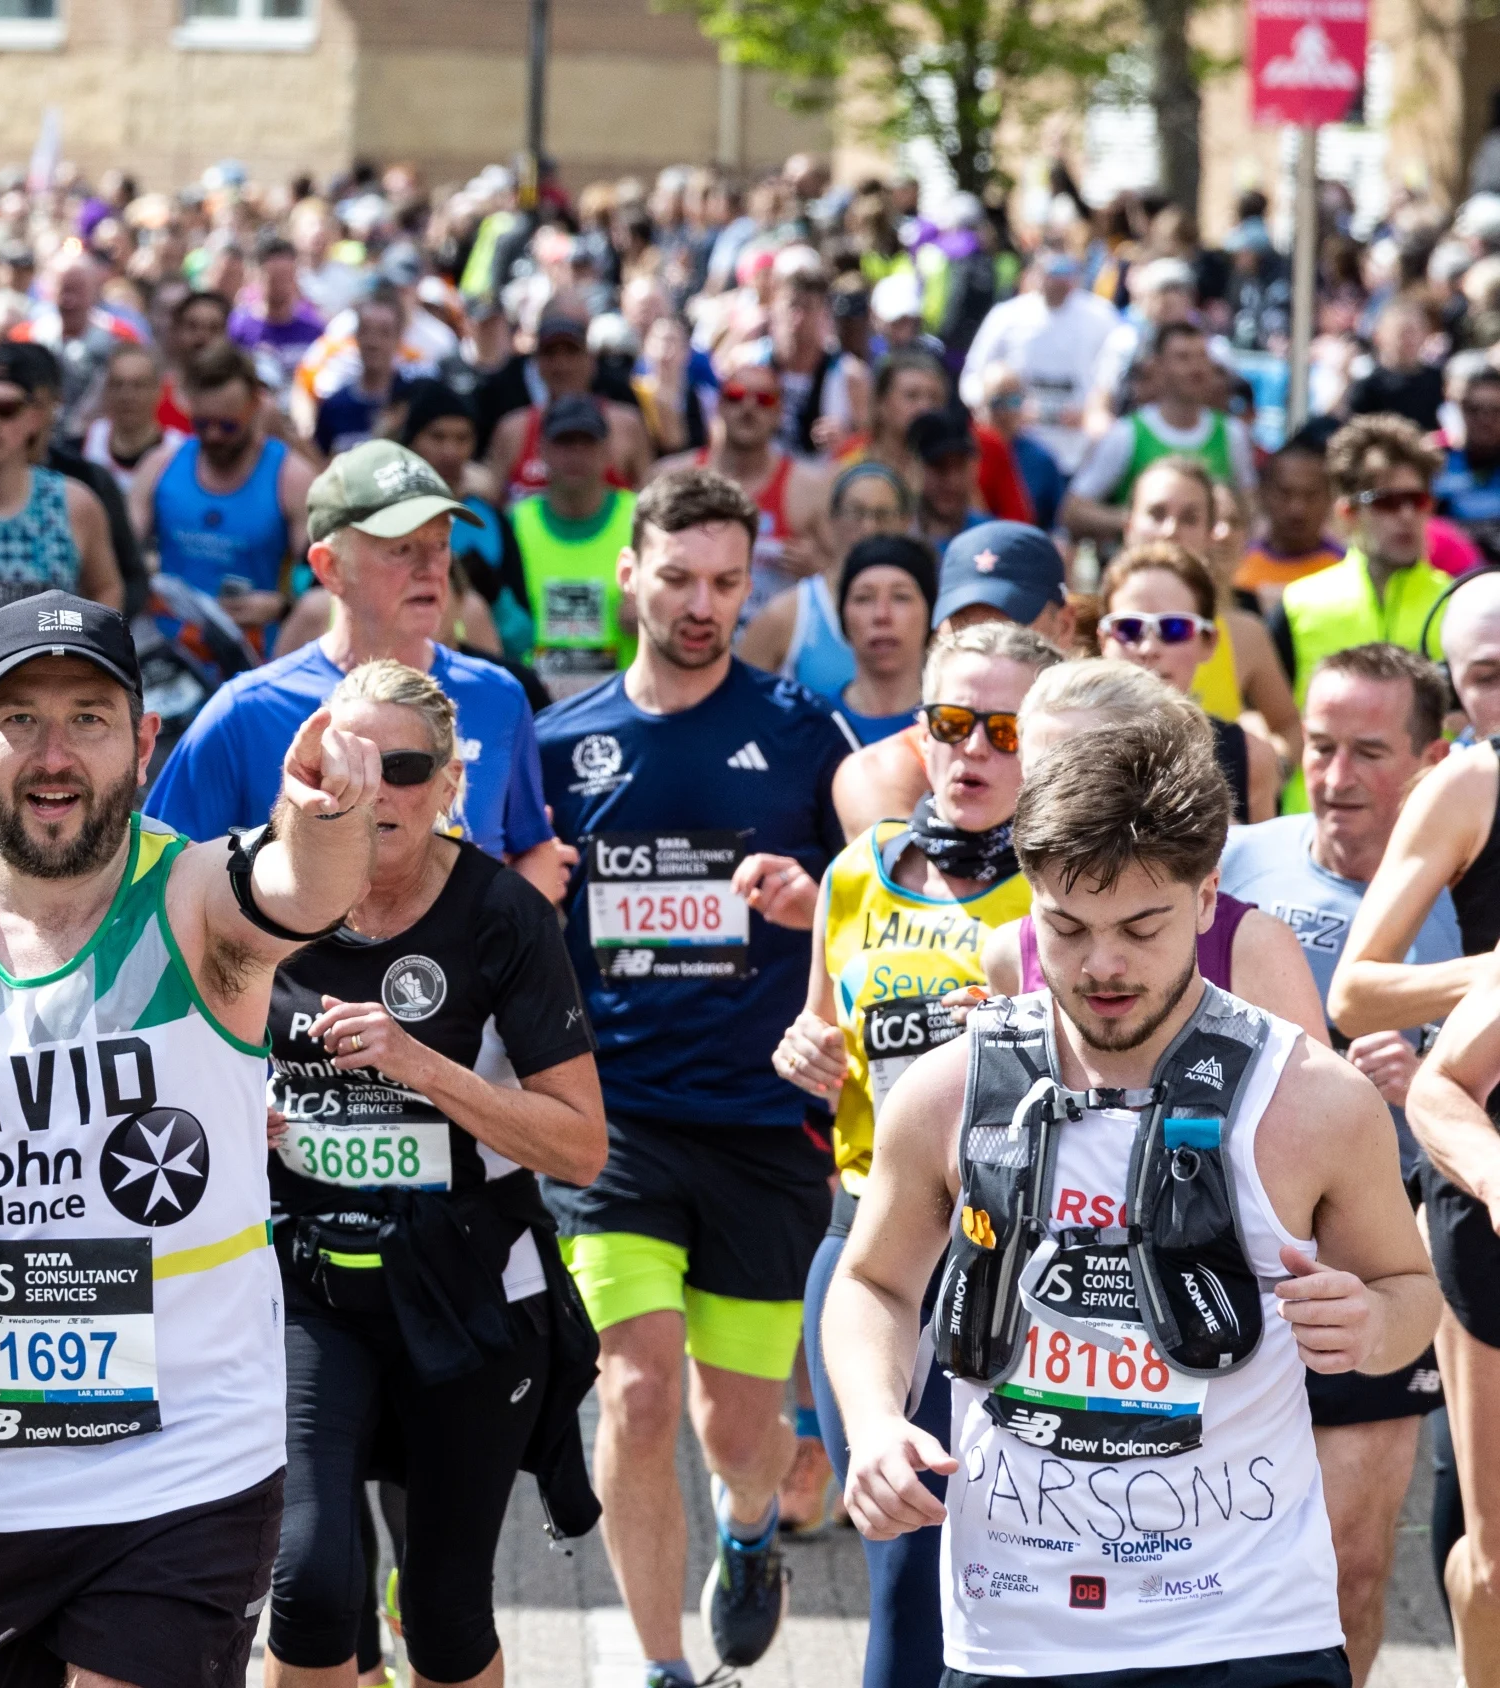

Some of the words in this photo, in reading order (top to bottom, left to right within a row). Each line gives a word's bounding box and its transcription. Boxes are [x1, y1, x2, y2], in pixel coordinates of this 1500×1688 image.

[38, 624, 83, 633] karrimor
[596, 839, 651, 877] tcs
[655, 849, 734, 863] CONSULTANCY
[655, 863, 708, 875] SERVICES
[616, 894, 722, 932] 12508
[862, 911, 981, 952] LAURA
[431, 966, 442, 982] CLUB
[653, 963, 680, 977] new
[681, 961, 736, 976] balance
[871, 1010, 924, 1051] tcs
[1184, 1071, 1224, 1091] AONIJIE
[283, 1085, 341, 1117] tcs
[347, 1104, 403, 1115] SERVICES
[297, 1135, 420, 1179] 36858
[1048, 1188, 1127, 1229] RS
[339, 1212, 368, 1224] new
[24, 1253, 73, 1267] TATA
[24, 1269, 139, 1284] CONSULTANCY
[25, 1287, 97, 1303] SERVICES
[949, 1269, 969, 1336] AONIJIE
[1181, 1272, 1221, 1334] AONIJIE
[1025, 1325, 1170, 1393] 18168
[78, 1389, 93, 1397] LAR,
[94, 1389, 124, 1397] RELAXED
[1121, 1400, 1140, 1409] SMA,
[1141, 1402, 1173, 1411] RELAXED
[25, 1425, 62, 1441] new
[66, 1420, 141, 1438] balance
[1061, 1437, 1098, 1453] new
[1102, 1437, 1182, 1457] balance
[960, 1446, 1274, 1541] PARSONS
[1142, 1532, 1158, 1540] THE
[1102, 1532, 1193, 1563] STOMPING
[1121, 1554, 1163, 1564] GROUND
[992, 1571, 1028, 1583] CANCER
[1165, 1572, 1222, 1597] MS-UK
[989, 1589, 1002, 1598] UK
[991, 1581, 1039, 1593] RESEARCH
